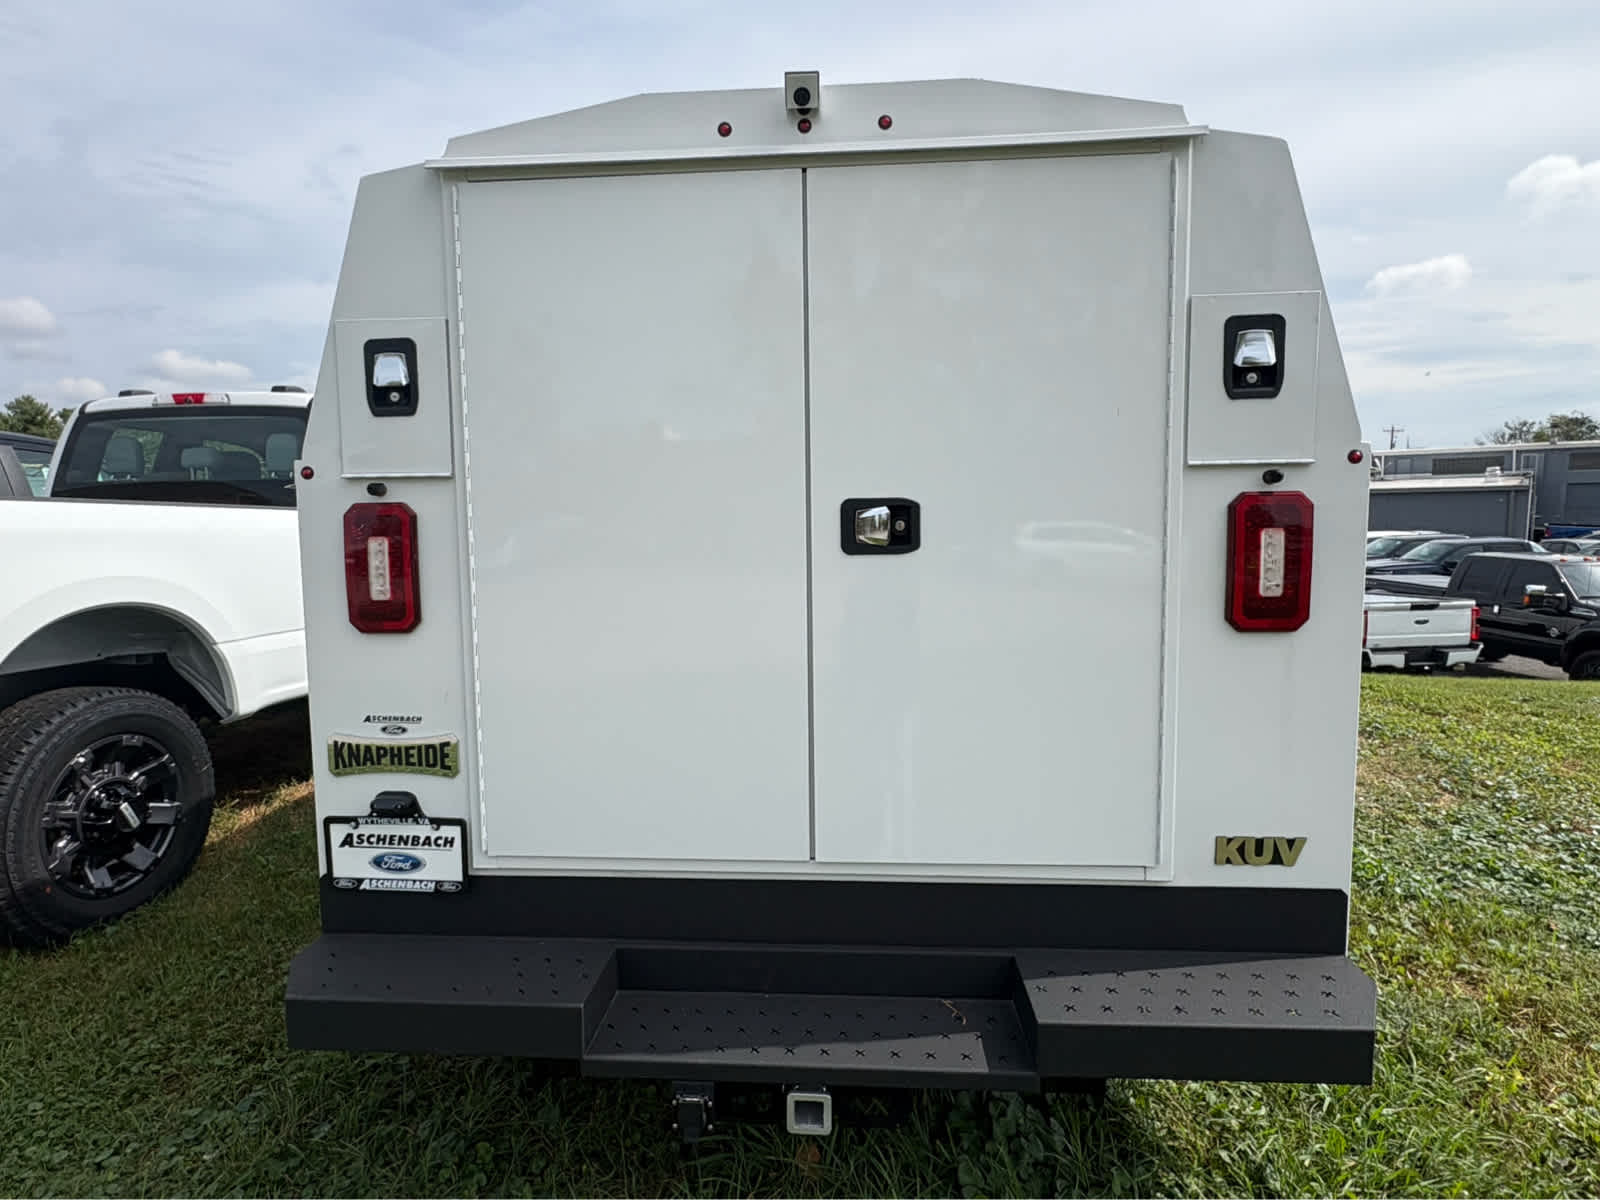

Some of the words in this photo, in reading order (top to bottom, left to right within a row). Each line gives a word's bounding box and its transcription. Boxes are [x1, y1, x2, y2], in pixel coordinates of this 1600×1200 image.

[333, 740, 452, 771] KNAPHEIDE
[418, 817, 431, 826] VA
[339, 833, 455, 849] ASCHENBACH
[1215, 836, 1307, 867] KUV
[359, 879, 435, 892] ASCHENBACH
